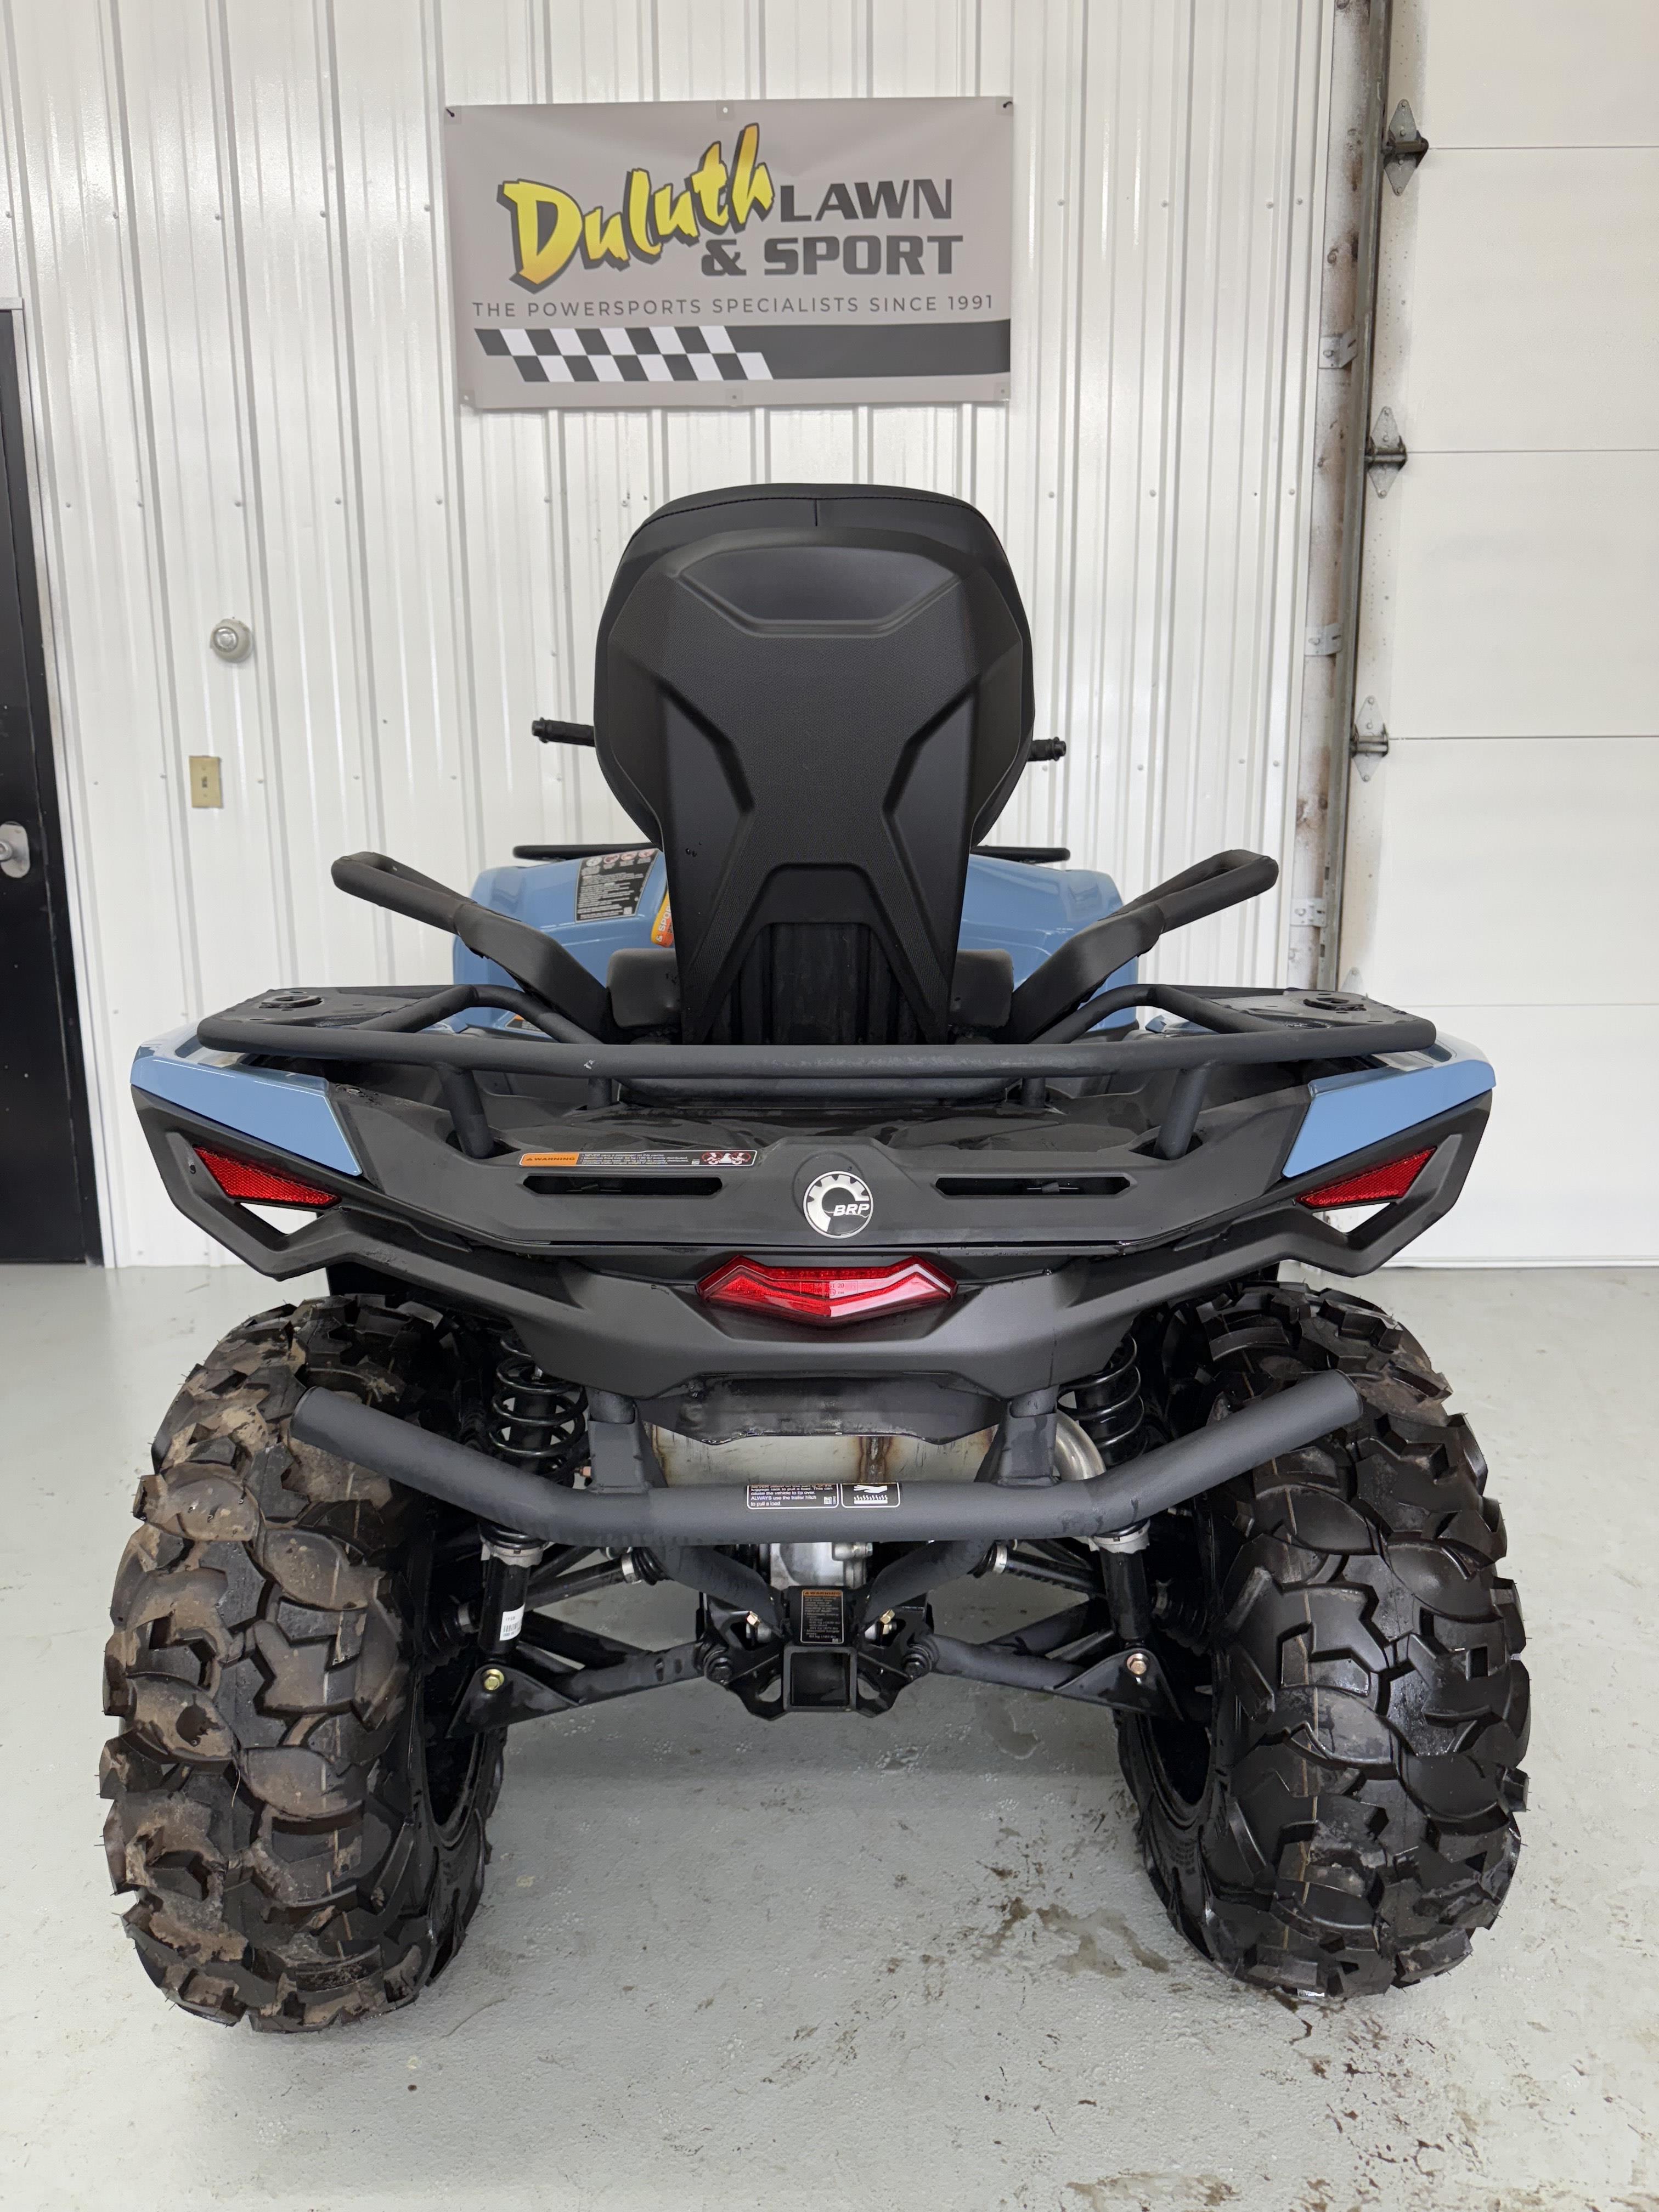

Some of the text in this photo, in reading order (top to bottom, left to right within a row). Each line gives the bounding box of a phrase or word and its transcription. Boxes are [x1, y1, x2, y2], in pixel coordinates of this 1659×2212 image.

[496, 123, 775, 295] Duluth
[780, 178, 952, 222] LAWN
[701, 235, 963, 276] & SPORT
[472, 294, 992, 317] THE POWERSPORTS SPECIALISTS SINCE 1991
[833, 1203, 870, 1217] BRP
